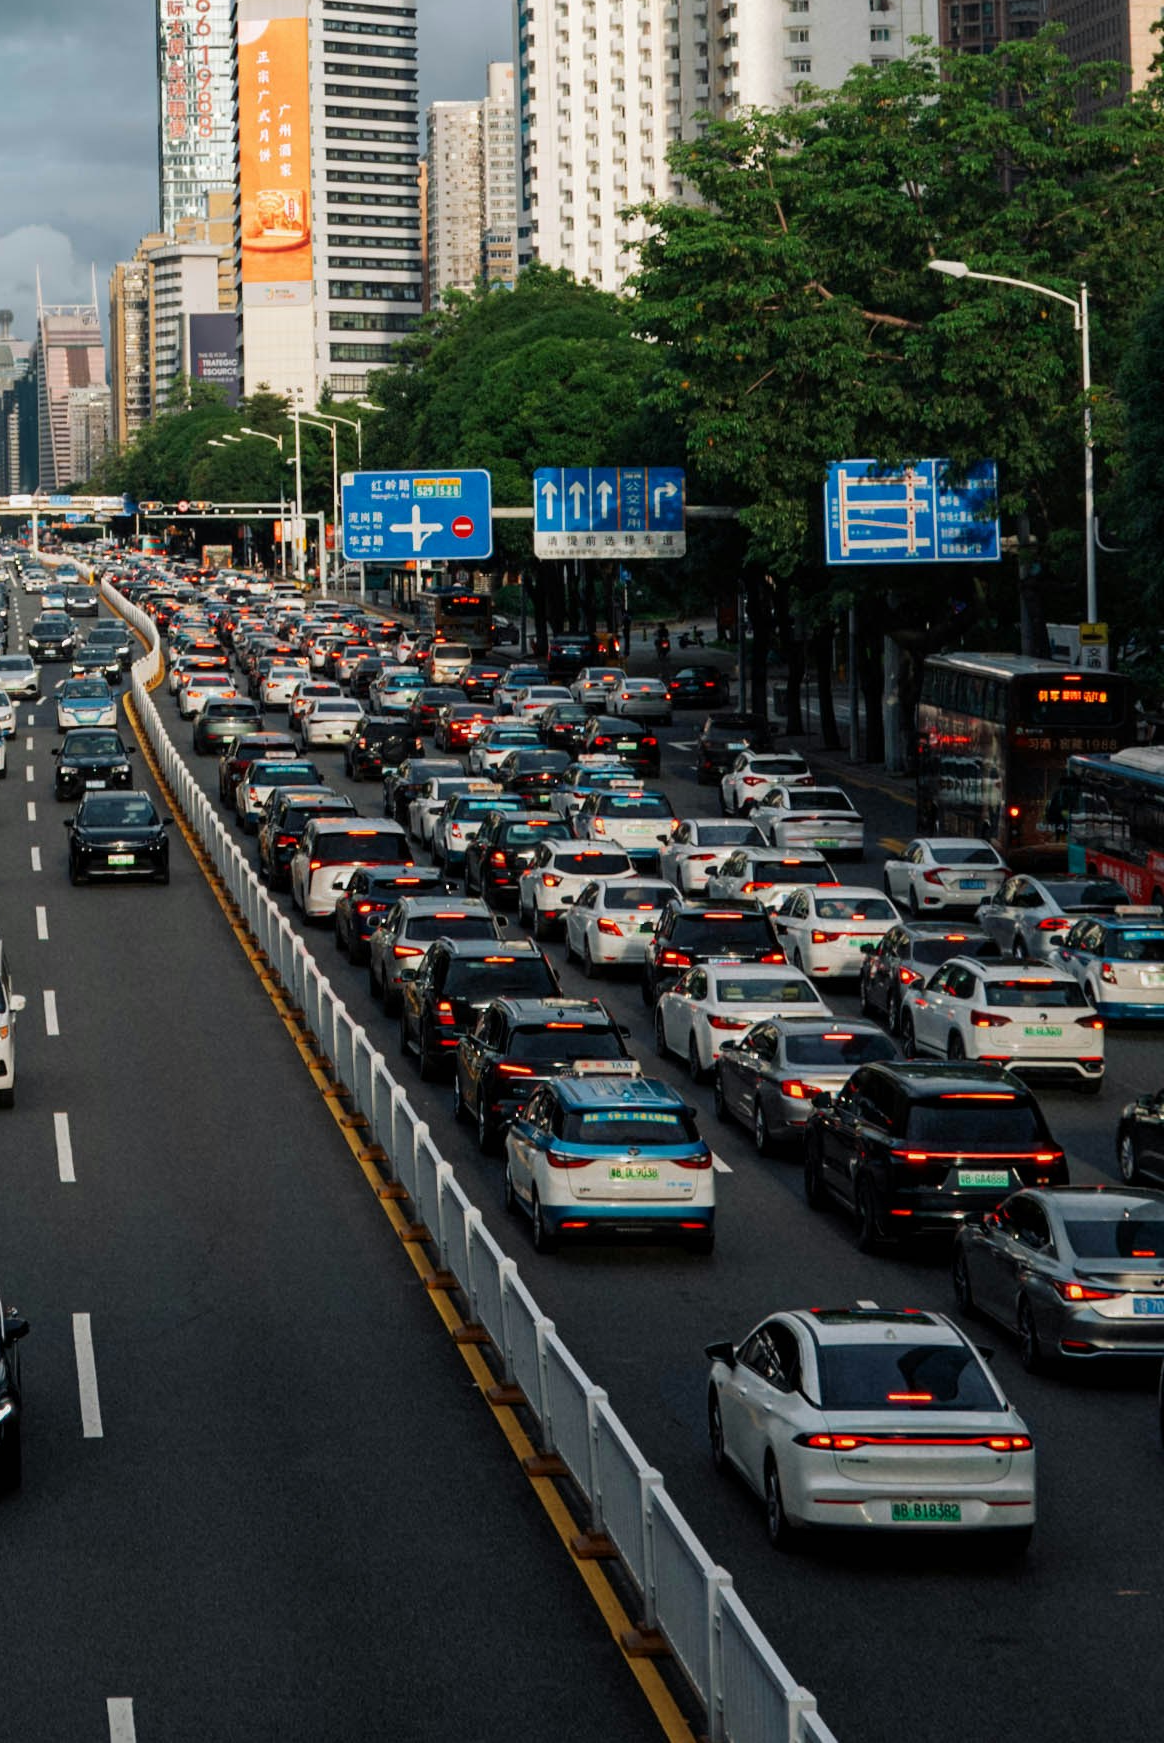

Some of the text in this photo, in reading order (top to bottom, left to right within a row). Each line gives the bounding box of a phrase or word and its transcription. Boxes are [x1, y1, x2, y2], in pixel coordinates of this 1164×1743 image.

[371, 479, 410, 492] 红岭路
[349, 535, 384, 547] 华富路
[547, 535, 674, 546] 请提前选择车道
